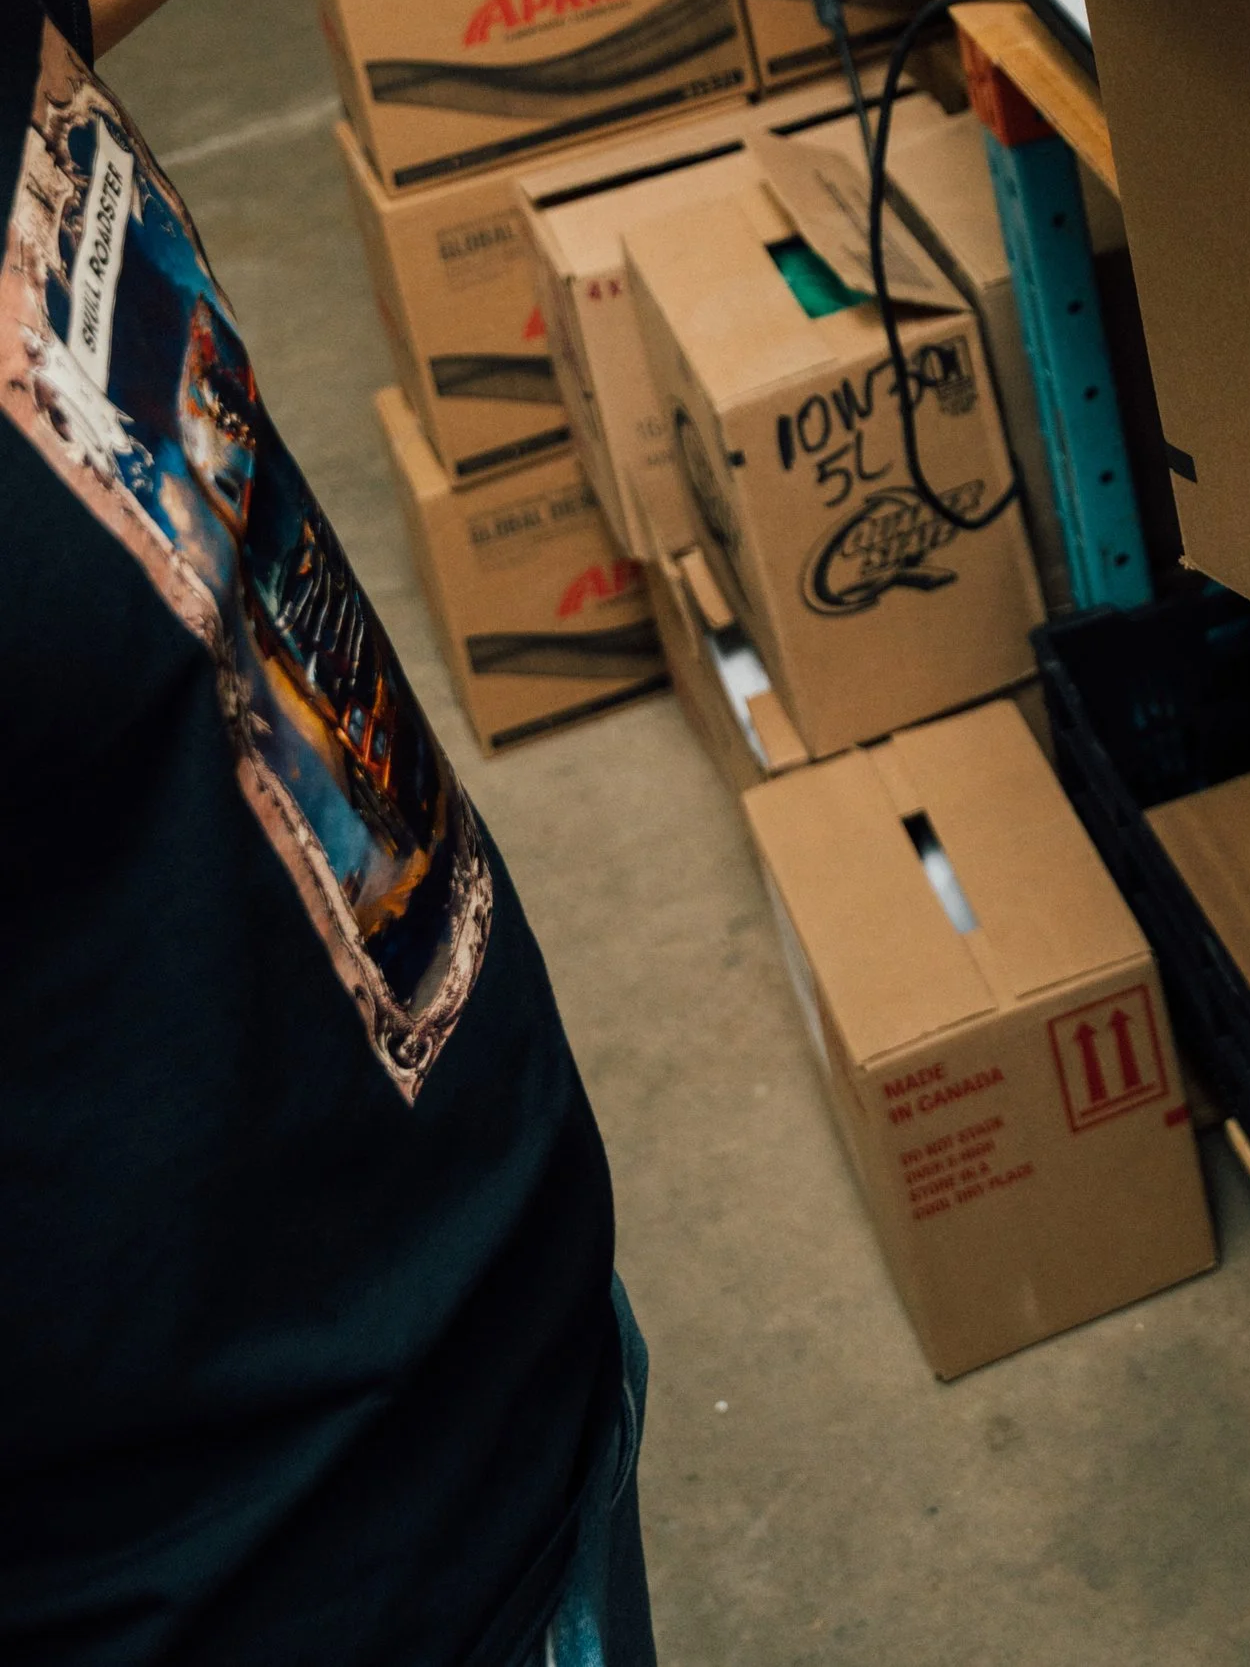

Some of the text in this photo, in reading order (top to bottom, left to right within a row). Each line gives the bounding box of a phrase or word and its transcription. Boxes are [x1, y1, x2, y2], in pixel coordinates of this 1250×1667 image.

[81, 161, 123, 353] SKULL ROADSTER
[815, 430, 894, 508] 5L
[883, 1062, 944, 1100] MADE
[887, 1066, 1005, 1126] IN CANADA
